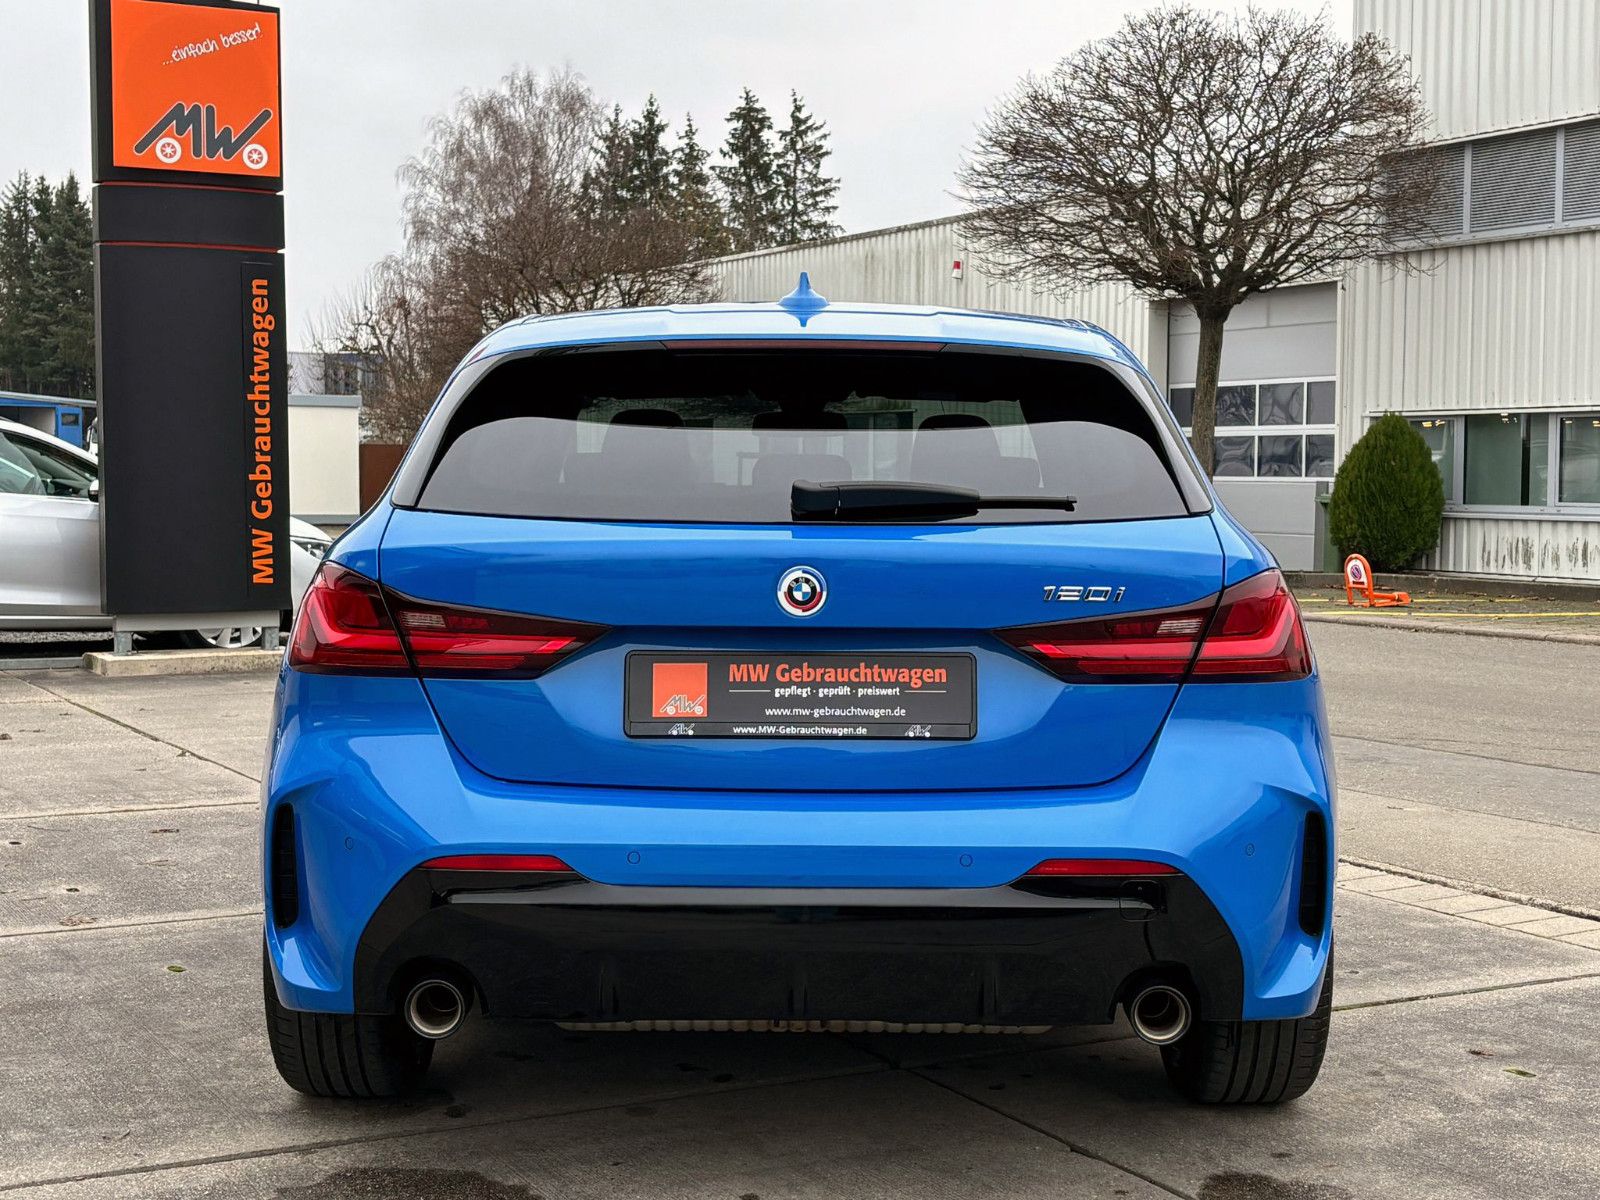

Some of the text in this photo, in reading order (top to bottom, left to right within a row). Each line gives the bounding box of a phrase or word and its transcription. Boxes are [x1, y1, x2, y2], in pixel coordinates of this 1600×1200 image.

[134, 101, 272, 160] MW
[246, 278, 275, 584] MW Gebrauchtwagen
[1043, 585, 1126, 602] 120i
[729, 662, 947, 688] MW Gebrauchtwagen
[774, 685, 900, 698] gepflegt geprüft preiswert
[765, 706, 906, 718] www.mw-gebrauchtwagen.de
[732, 725, 868, 736] www.MW-Gebrauchtwagen.de
